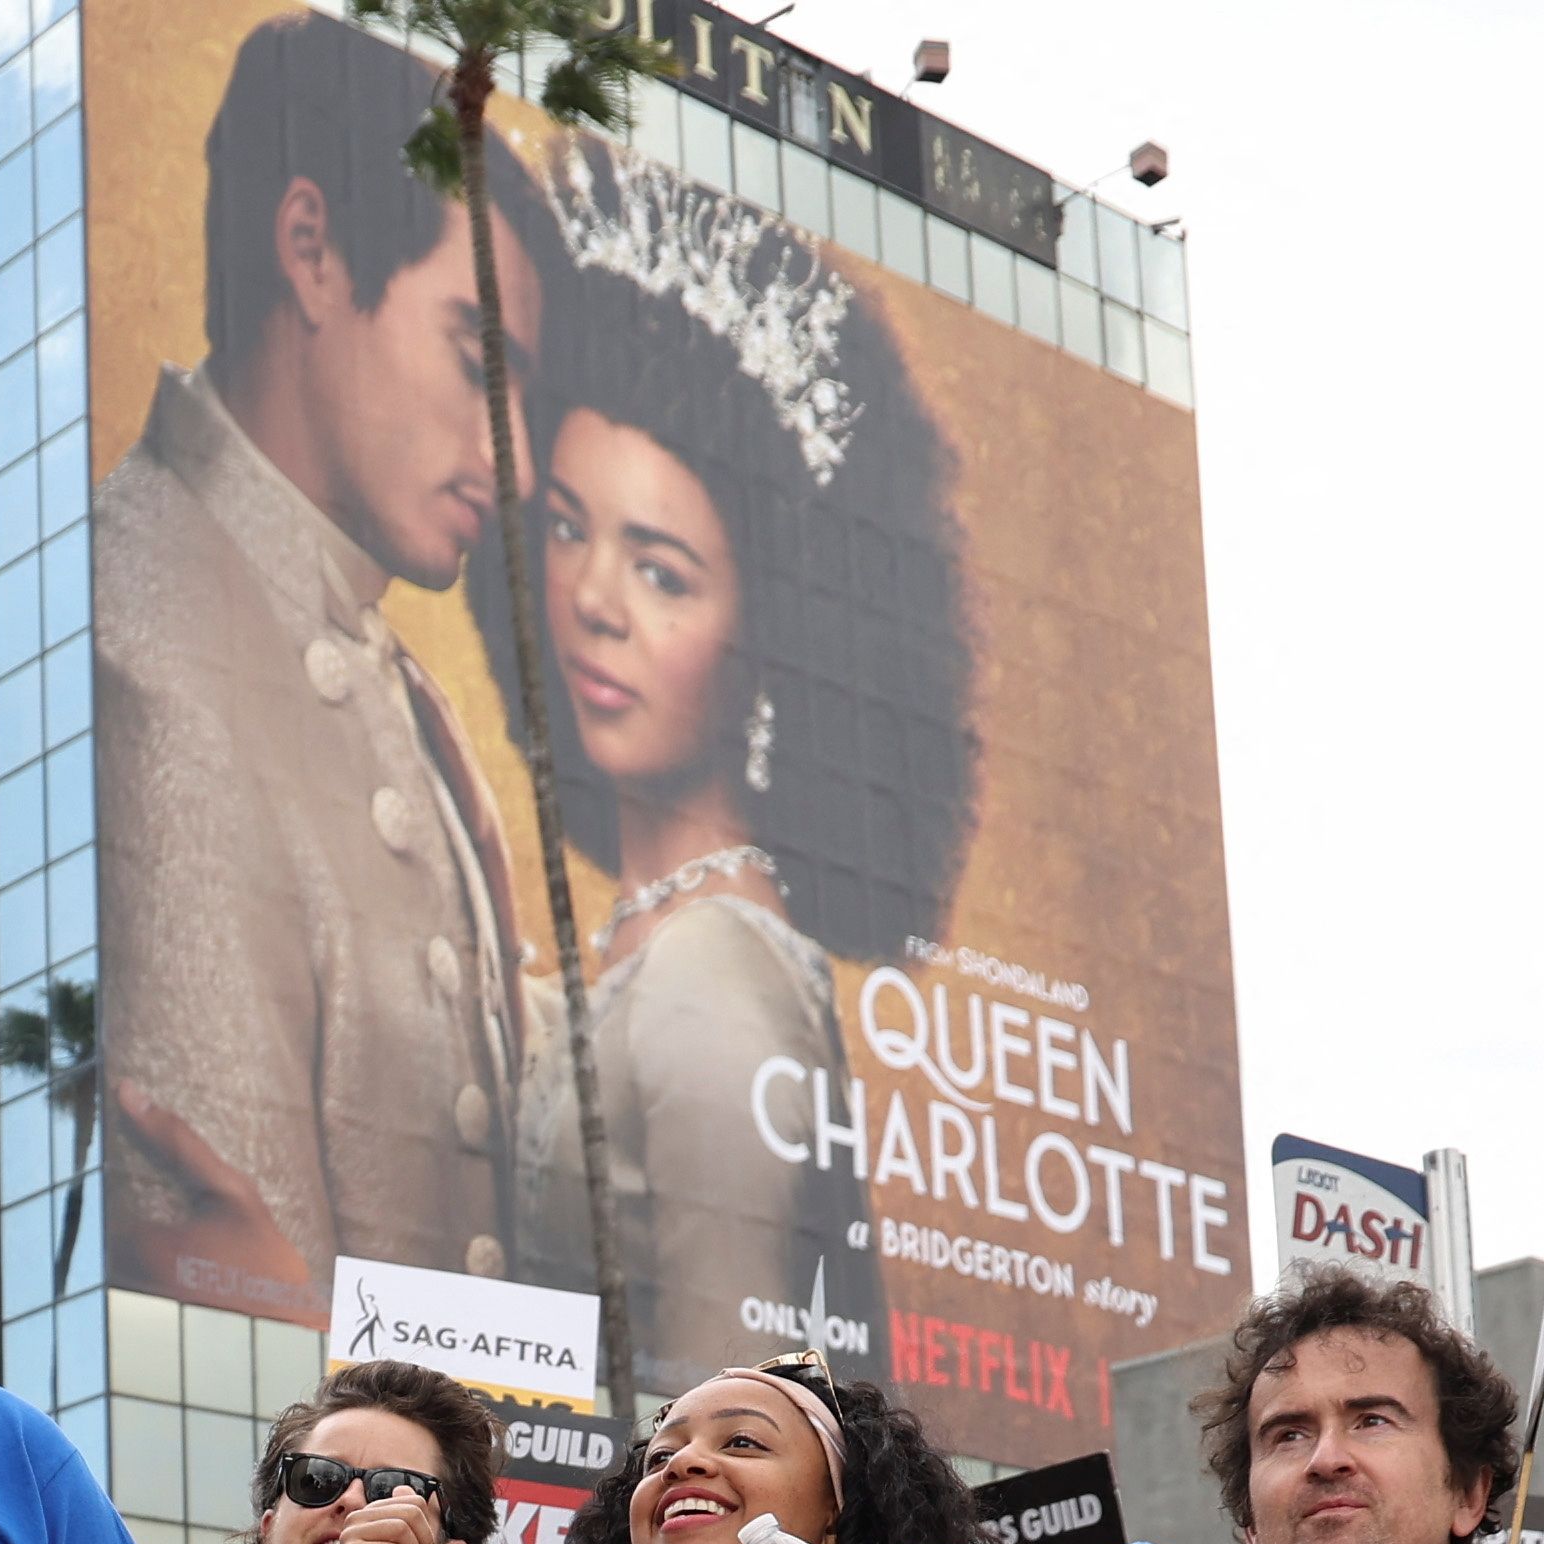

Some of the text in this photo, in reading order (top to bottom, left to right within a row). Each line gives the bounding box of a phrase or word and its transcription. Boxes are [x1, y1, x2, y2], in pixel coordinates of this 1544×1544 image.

[860, 966, 1133, 1135] QUEEN
[752, 1056, 1232, 1276] CHARLOTTE
[847, 1217, 1158, 1328] a BRIDGERTON story
[1292, 1191, 1424, 1270] DASH
[824, 1316, 869, 1354] ON
[888, 1308, 1075, 1420] NETFLIX
[507, 1420, 614, 1471] GUILD
[1019, 1493, 1104, 1542] GUILD
